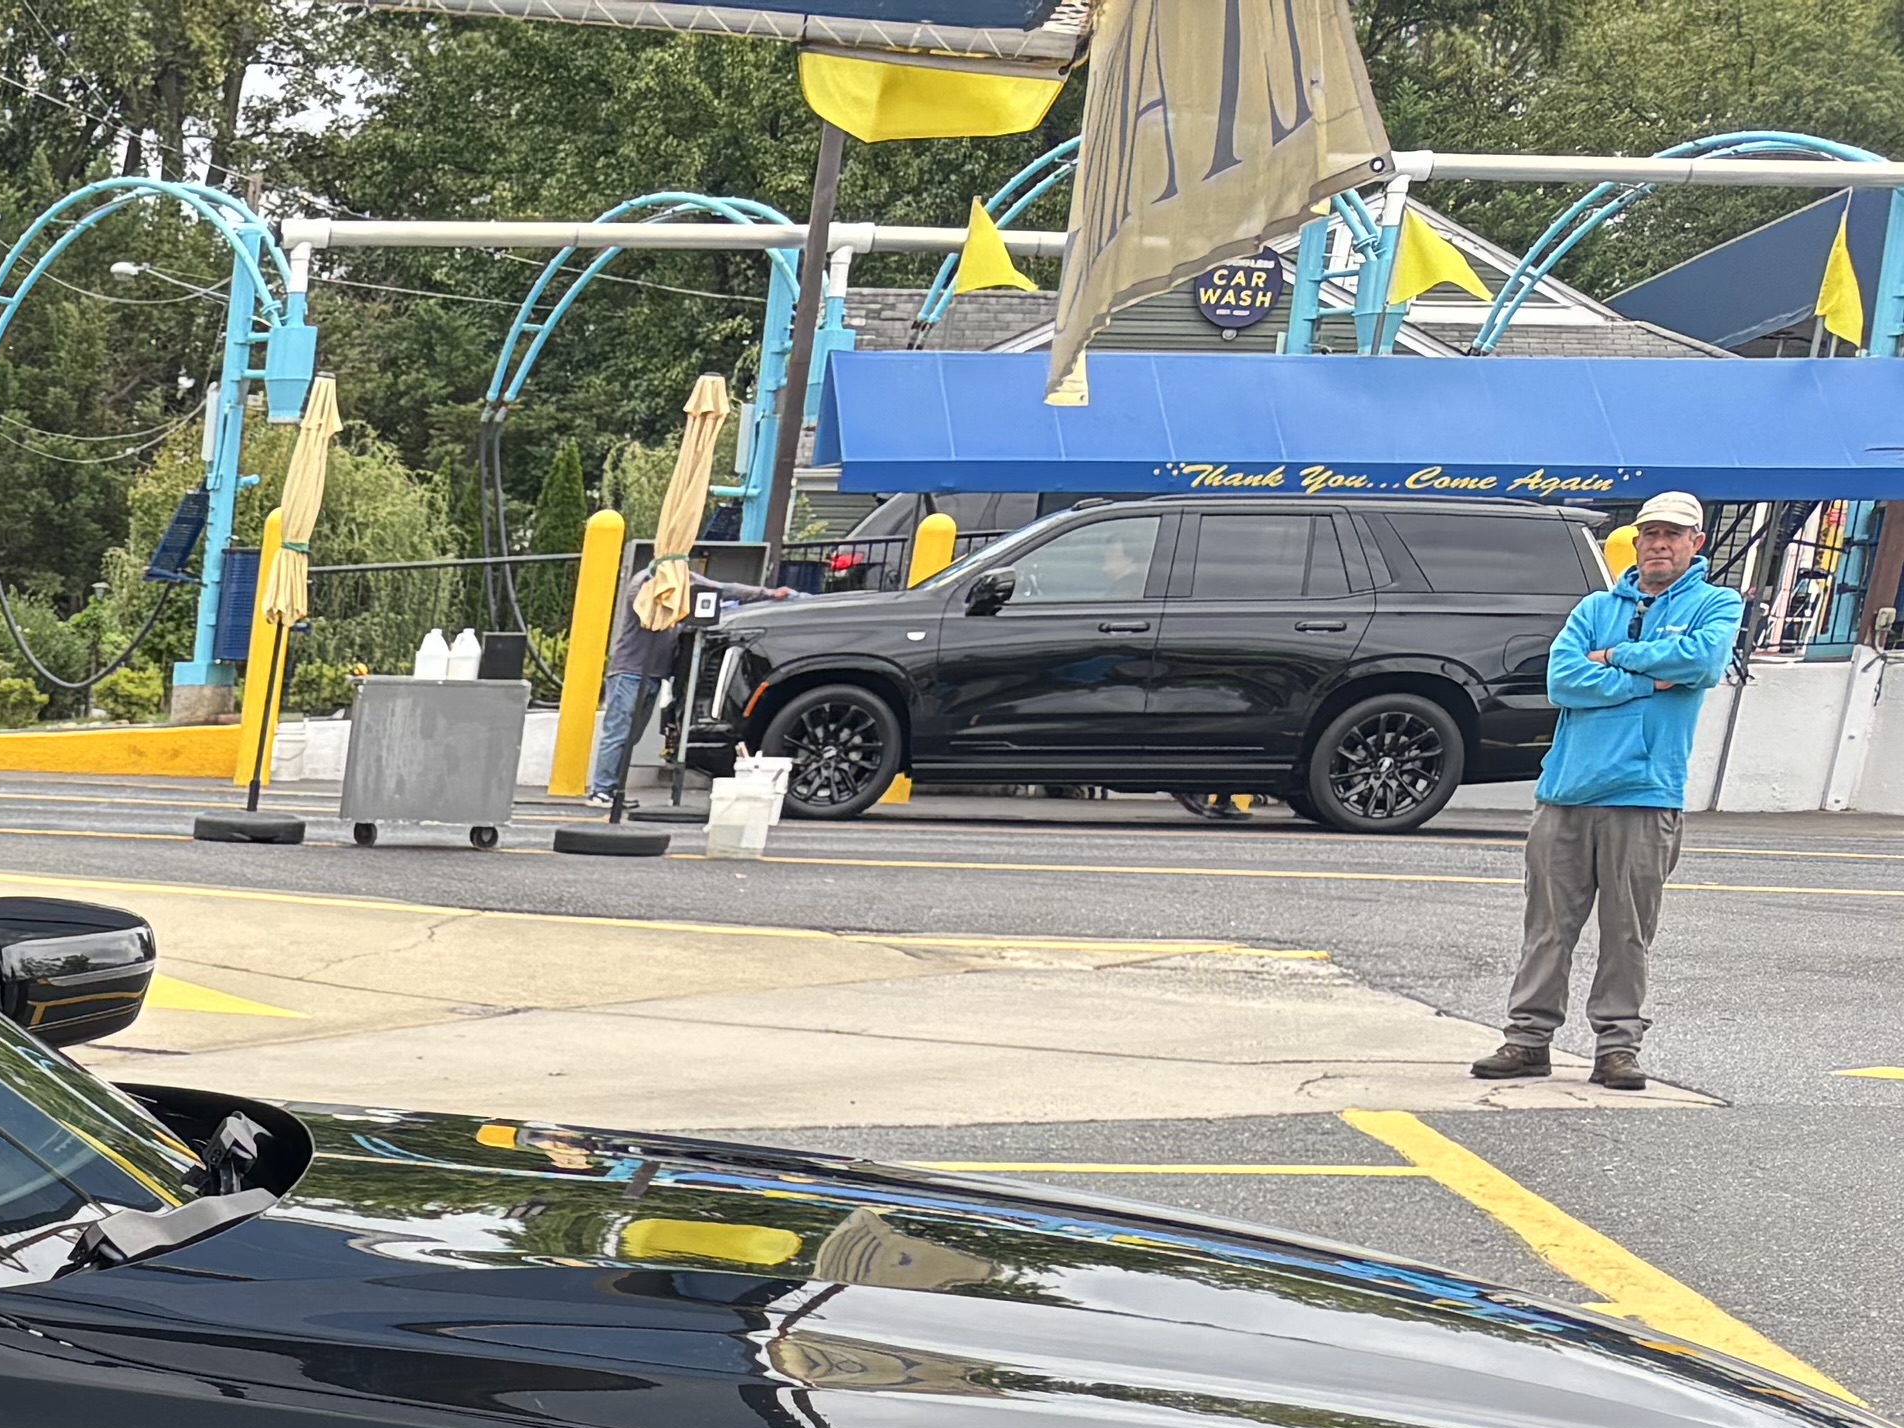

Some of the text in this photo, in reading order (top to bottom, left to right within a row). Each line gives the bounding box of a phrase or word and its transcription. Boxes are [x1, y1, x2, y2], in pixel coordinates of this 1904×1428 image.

[1213, 269, 1267, 287] CAR
[1199, 287, 1272, 307] WASH
[1182, 464, 1285, 488] Thank
[1506, 468, 1614, 497] Again
